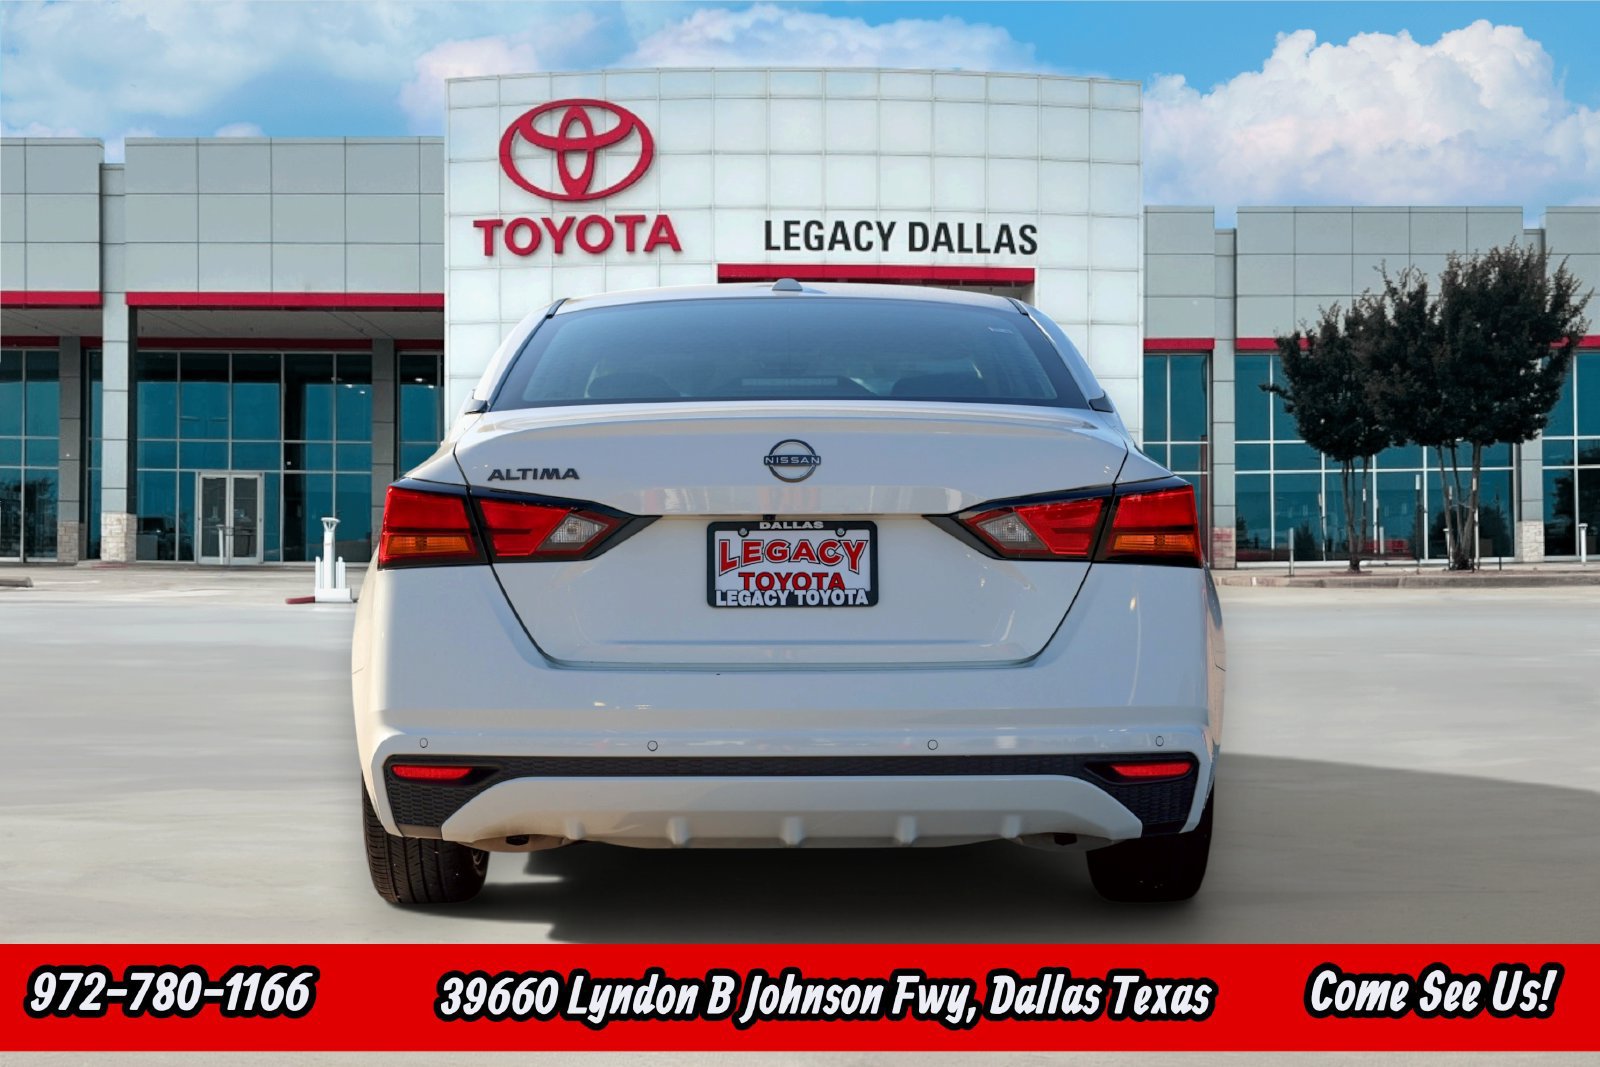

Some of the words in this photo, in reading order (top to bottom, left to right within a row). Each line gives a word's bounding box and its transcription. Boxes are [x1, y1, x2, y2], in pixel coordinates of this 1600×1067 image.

[474, 214, 682, 256] TOYOTA
[764, 220, 897, 253] LEGACY
[908, 221, 1038, 255] DALLAS
[765, 456, 820, 464] NISSAN
[487, 468, 581, 482] ALTIMA
[759, 521, 824, 530] DALLAS
[719, 539, 868, 576] LEGACY
[738, 572, 846, 591] TOYOTA
[716, 590, 789, 606] LEGACY
[794, 589, 868, 606] TOYOTA
